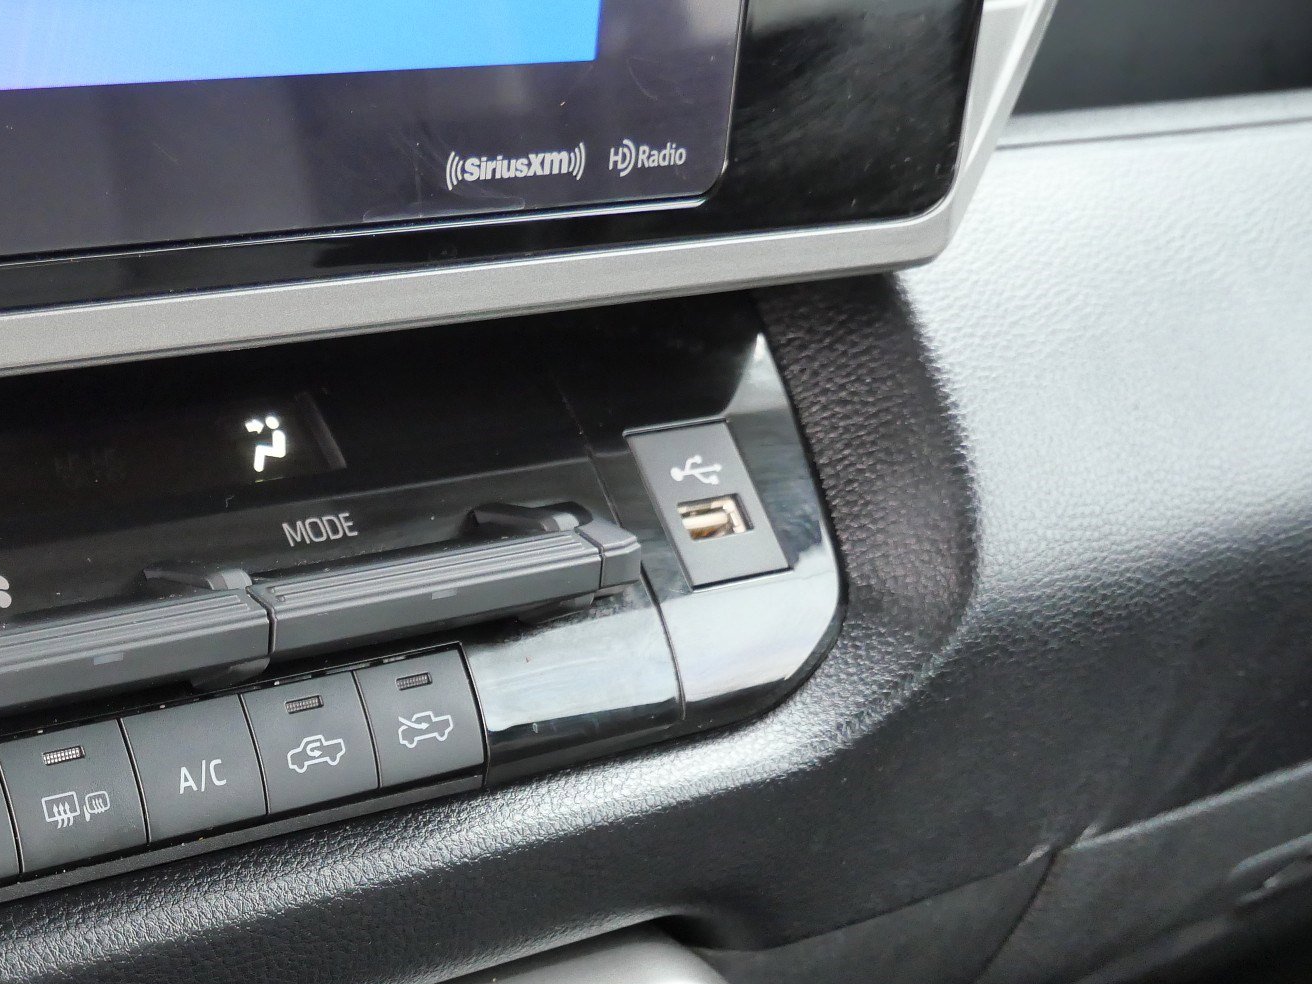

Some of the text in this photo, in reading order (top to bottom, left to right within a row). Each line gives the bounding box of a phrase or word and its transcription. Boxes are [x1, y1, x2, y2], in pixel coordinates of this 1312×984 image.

[608, 142, 686, 175] HD Radio
[282, 512, 358, 547] MODE
[180, 758, 227, 795] A/C
